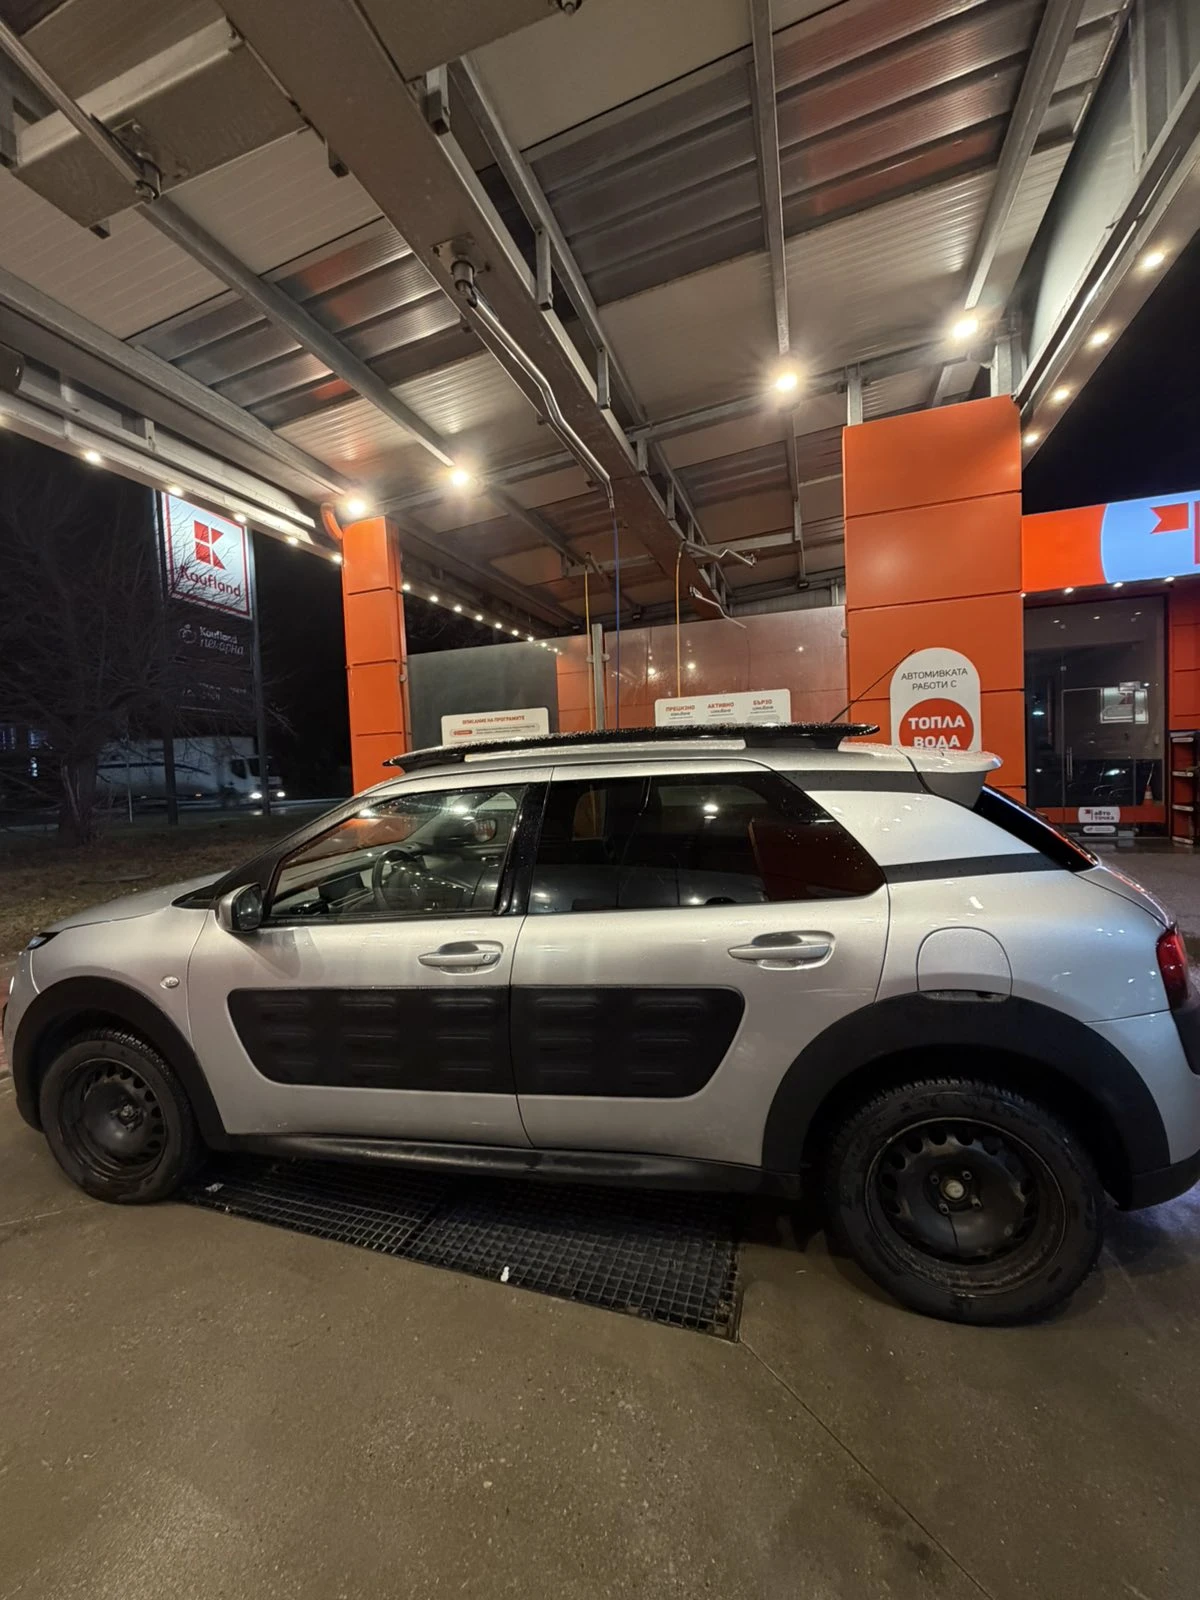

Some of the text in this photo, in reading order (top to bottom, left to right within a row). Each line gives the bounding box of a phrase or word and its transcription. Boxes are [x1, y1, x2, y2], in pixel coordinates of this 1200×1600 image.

[179, 565, 242, 597] Kaufland
[901, 668, 968, 680] АВТОМИВКАТА
[912, 680, 957, 691] РАБОТИ С
[908, 715, 966, 730] ТОПЛА
[913, 734, 961, 750] ВОДА
